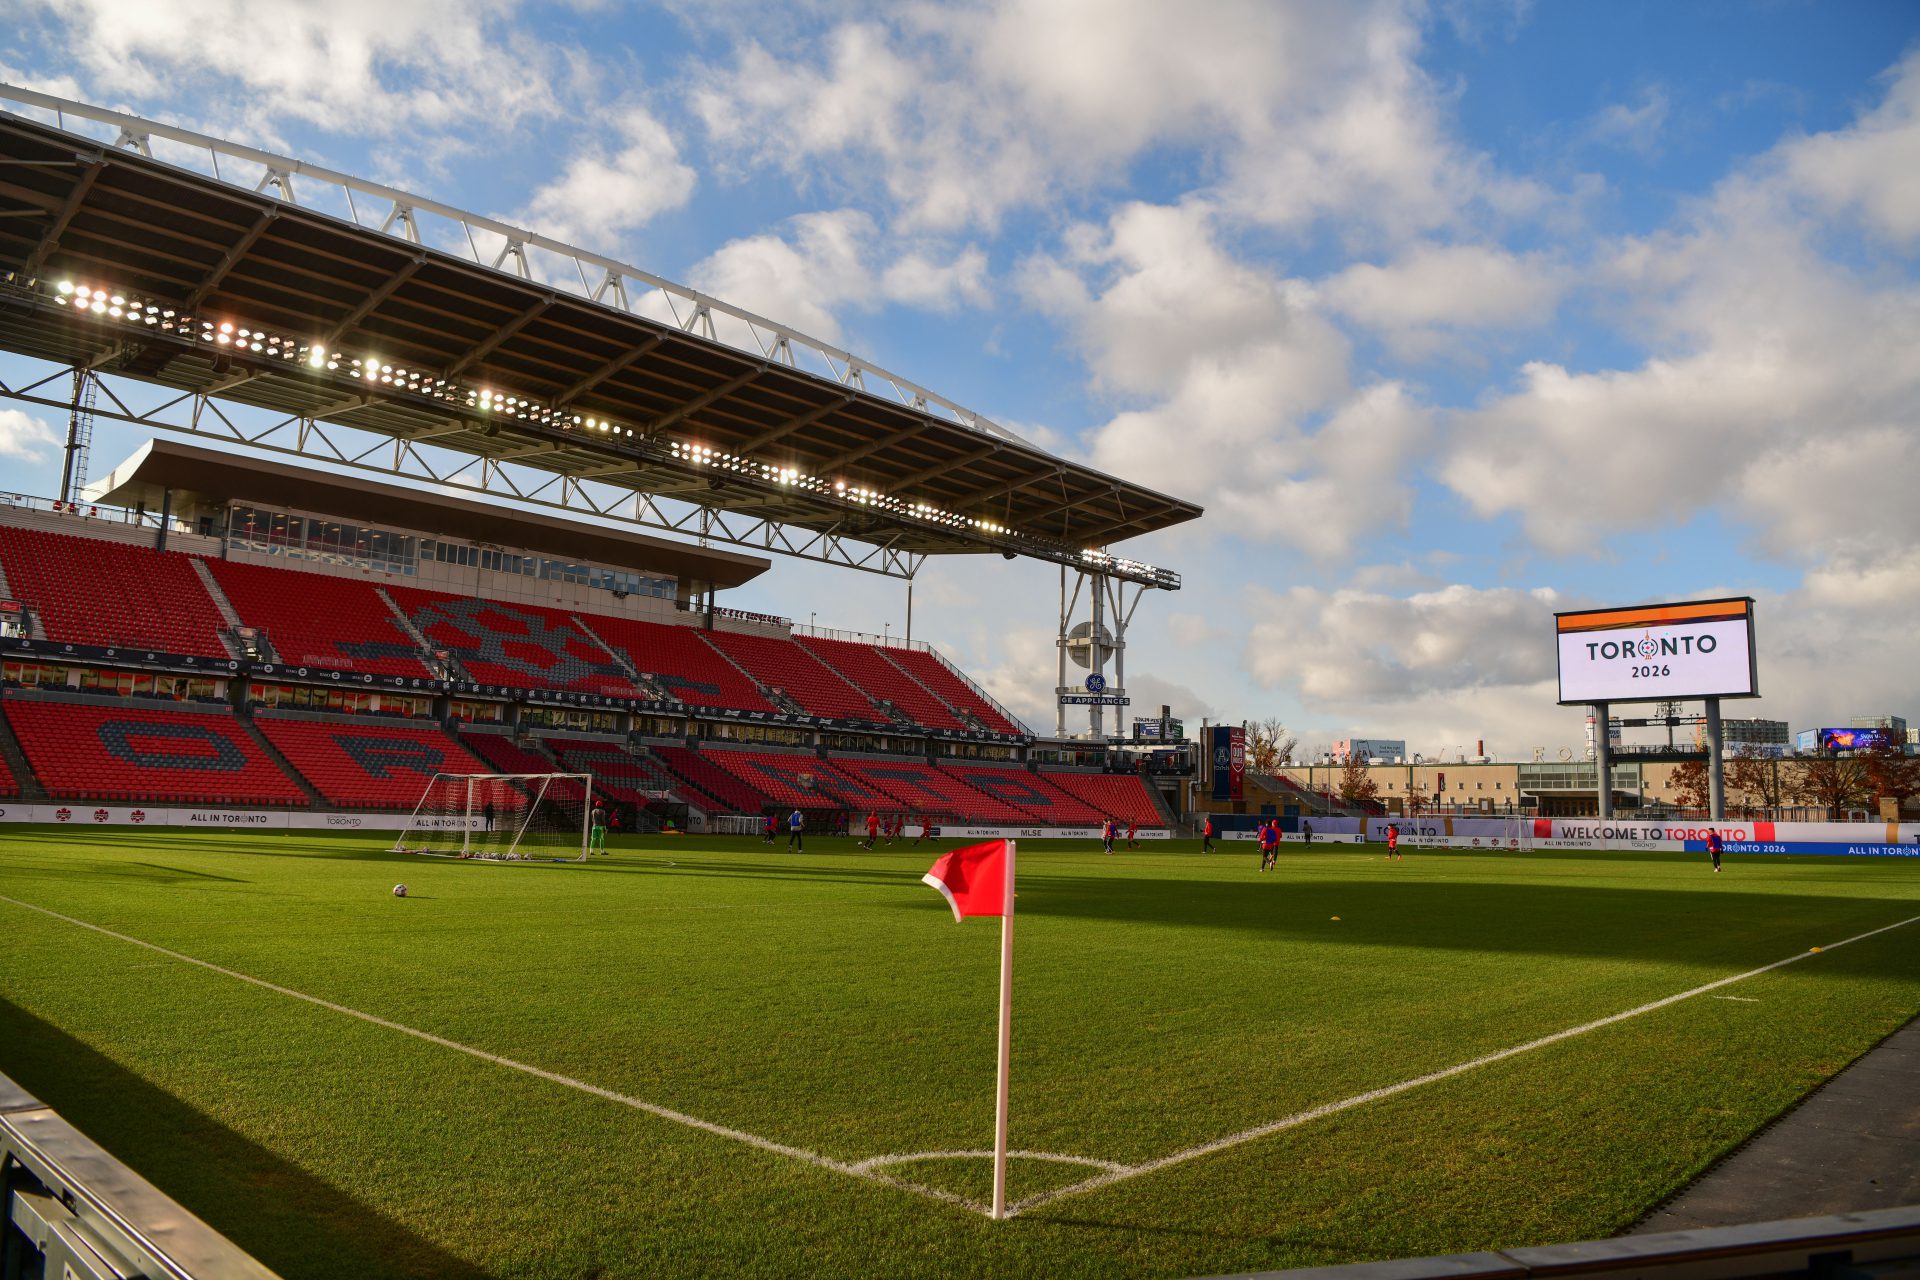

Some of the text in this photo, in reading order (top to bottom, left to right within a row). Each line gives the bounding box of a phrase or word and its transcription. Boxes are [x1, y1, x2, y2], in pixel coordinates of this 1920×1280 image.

[1586, 633, 1717, 661] TORONTO
[1632, 665, 1671, 678] 2026
[1075, 697, 1130, 705] APPLIANCES
[210, 814, 220, 822] IN
[223, 813, 267, 823] TORONTO
[327, 818, 361, 826] TORONTO
[1021, 829, 1042, 837] MLSE
[1562, 827, 1637, 840] WELCOME
[1641, 828, 1662, 840] TO
[1721, 843, 1786, 853] ORONTO 2026
[1848, 846, 1920, 856] ALL IN TORON
